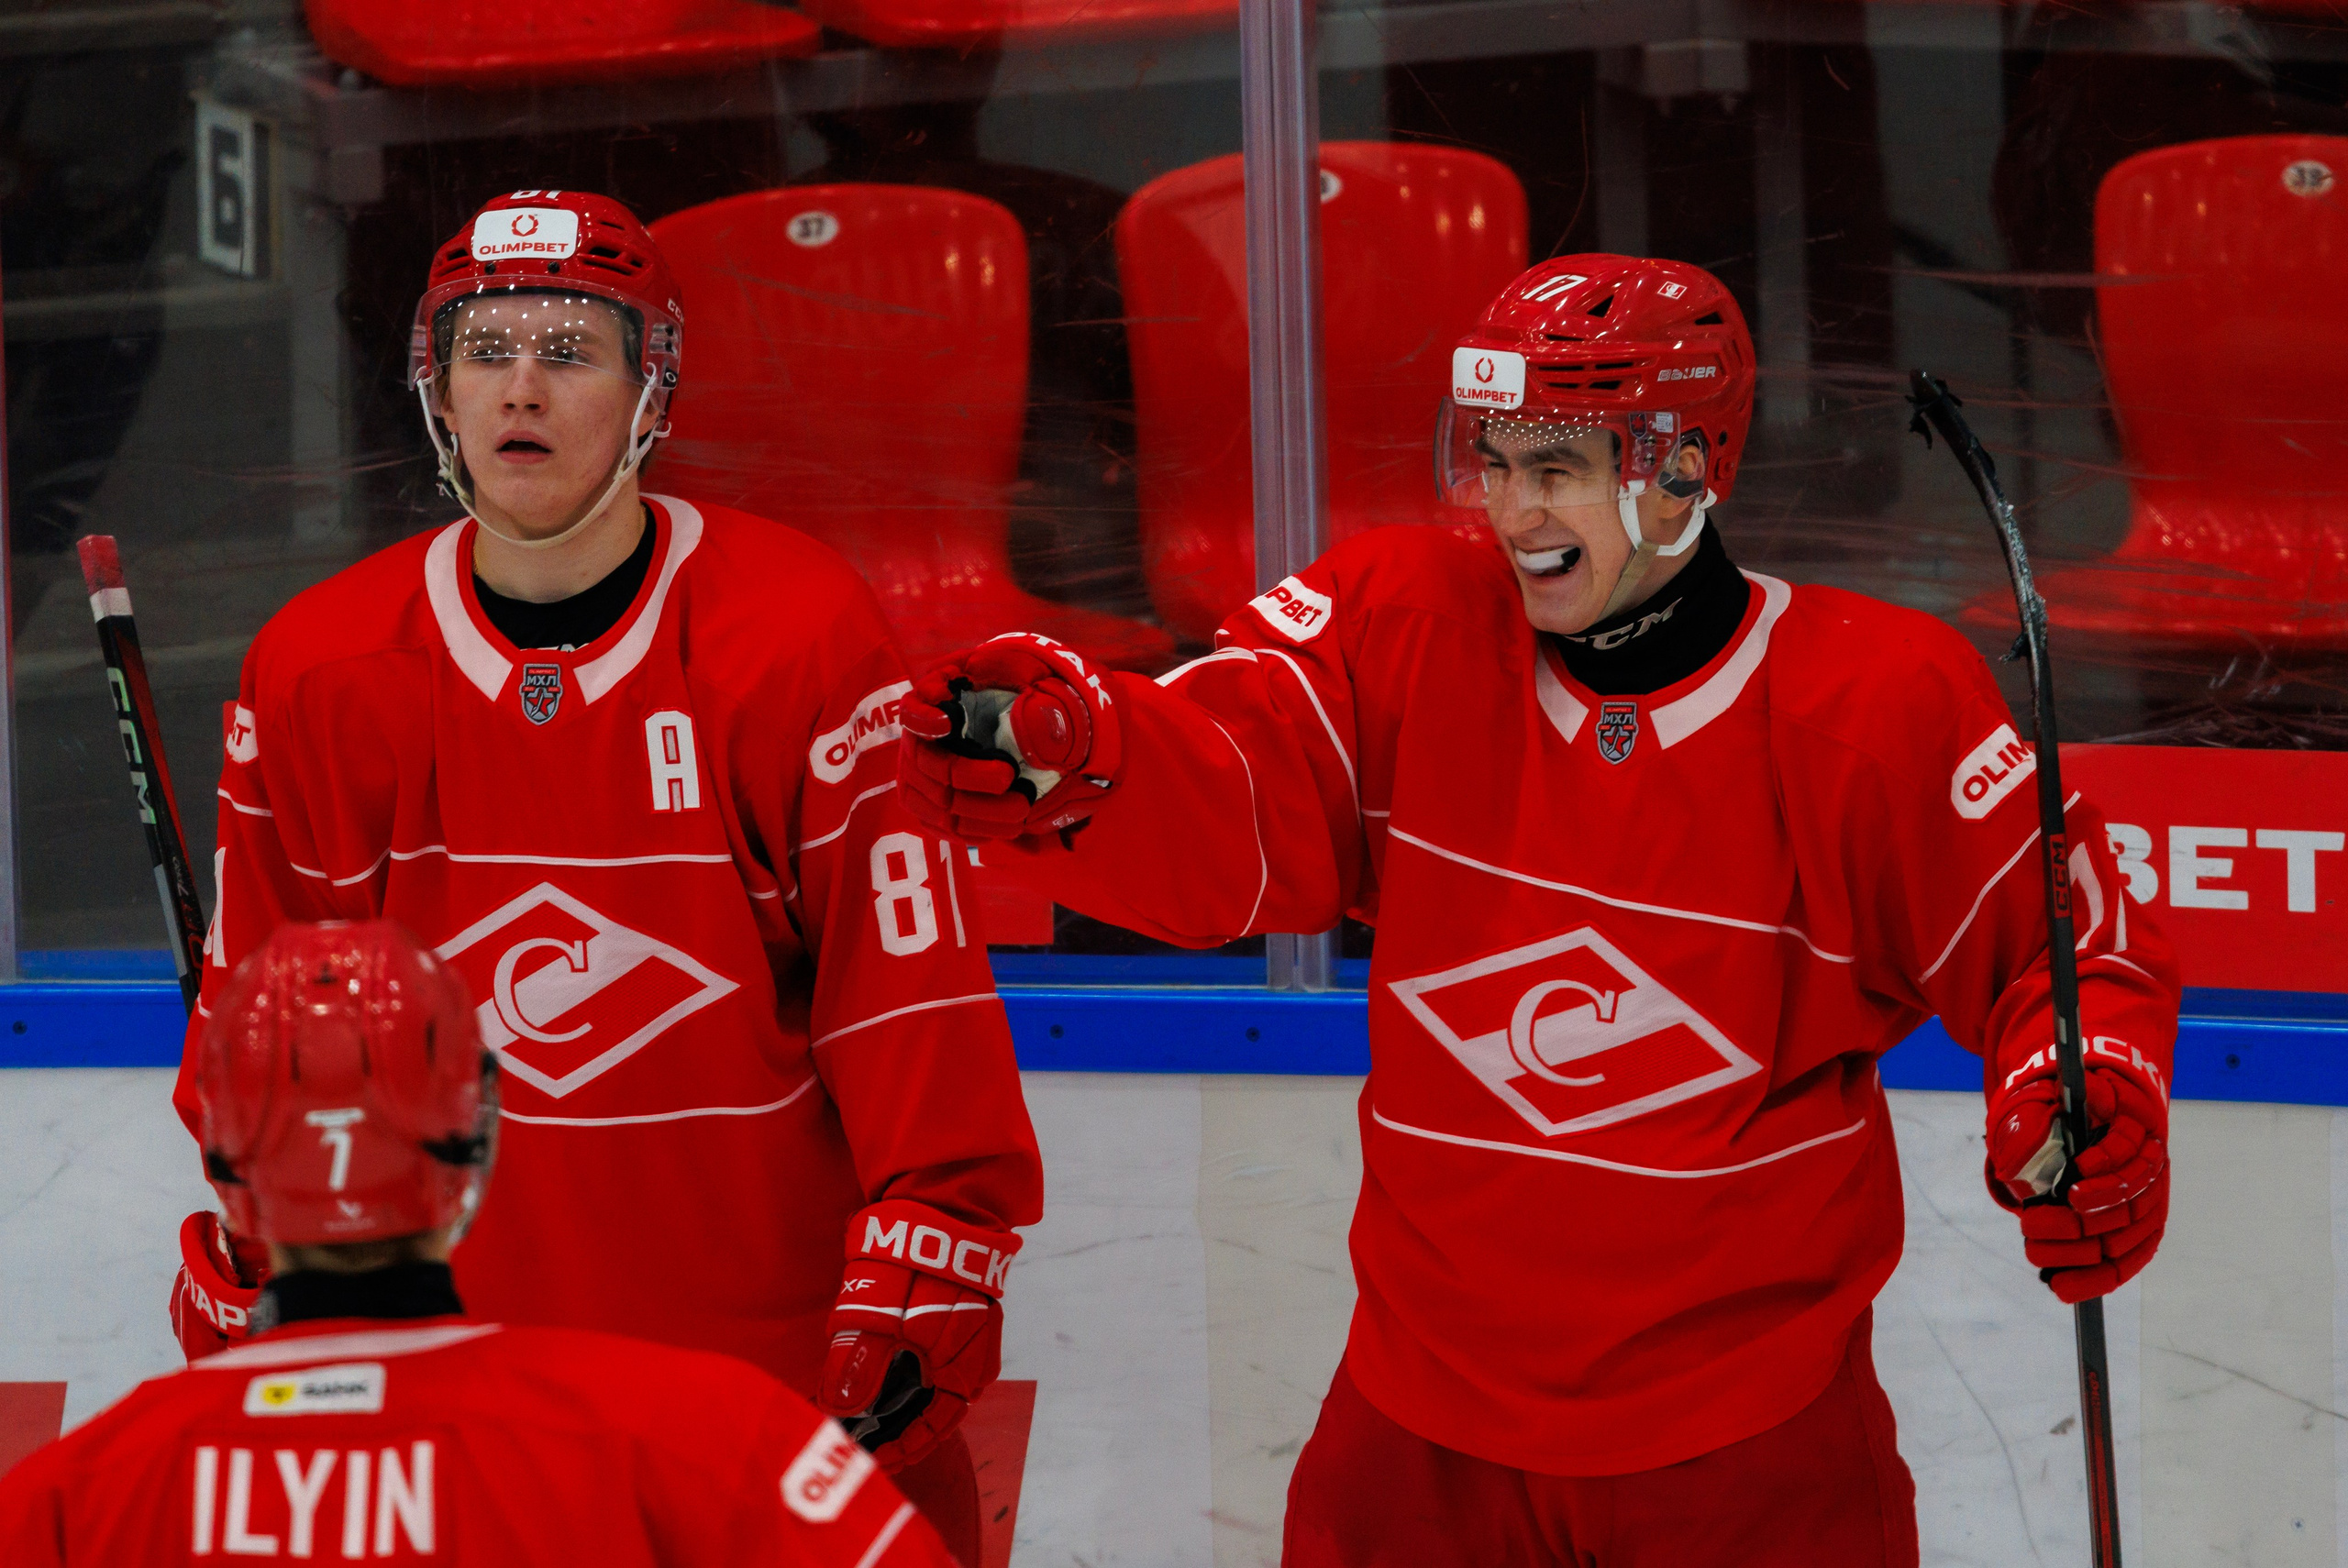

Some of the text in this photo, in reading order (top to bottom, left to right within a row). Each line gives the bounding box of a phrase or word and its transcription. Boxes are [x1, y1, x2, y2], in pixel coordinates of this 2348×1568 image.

[479, 241, 569, 255] OLIMPBET
[1522, 274, 1589, 303] 17
[1456, 387, 1518, 403] OLIMPBET
[526, 675, 557, 686] МХЛ
[1603, 713, 1633, 724] МХЛ
[106, 667, 158, 825] CCM
[645, 710, 701, 812] A
[2052, 840, 2069, 911] CCM
[841, 1278, 876, 1294] XF
[192, 1439, 436, 1560] ILYIN
